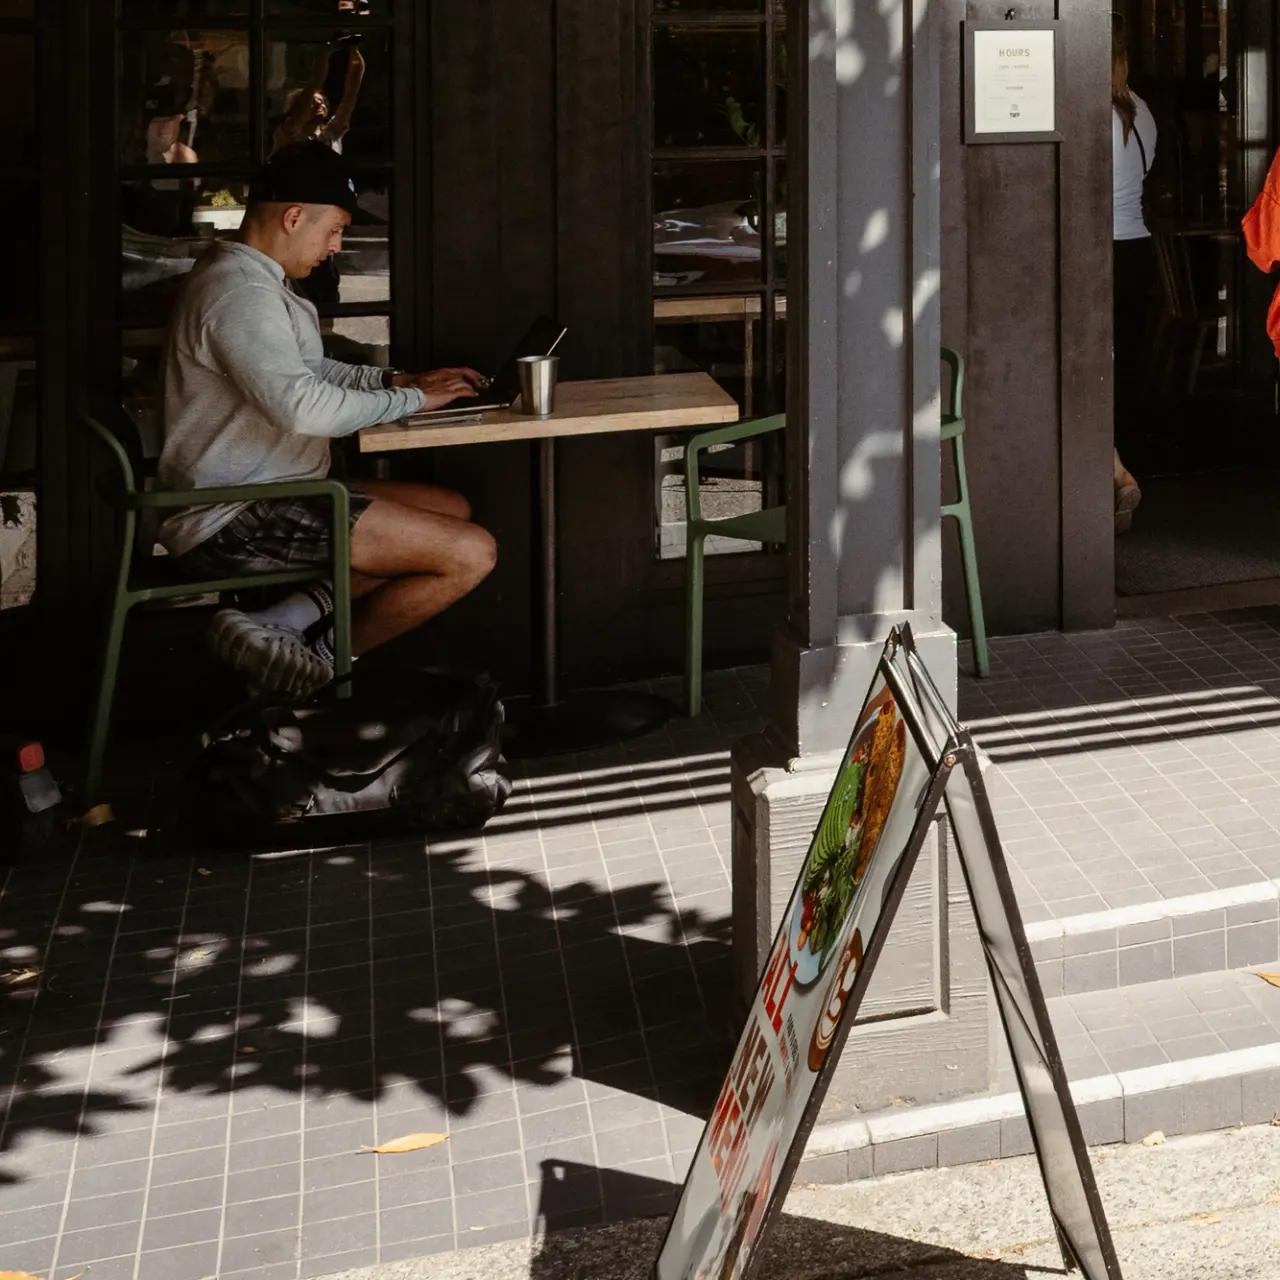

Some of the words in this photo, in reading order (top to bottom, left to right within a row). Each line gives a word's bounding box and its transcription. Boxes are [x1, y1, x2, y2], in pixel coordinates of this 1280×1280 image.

[999, 48, 1030, 57] HOURS
[761, 932, 798, 1037] ALL
[731, 1015, 775, 1137] NEW
